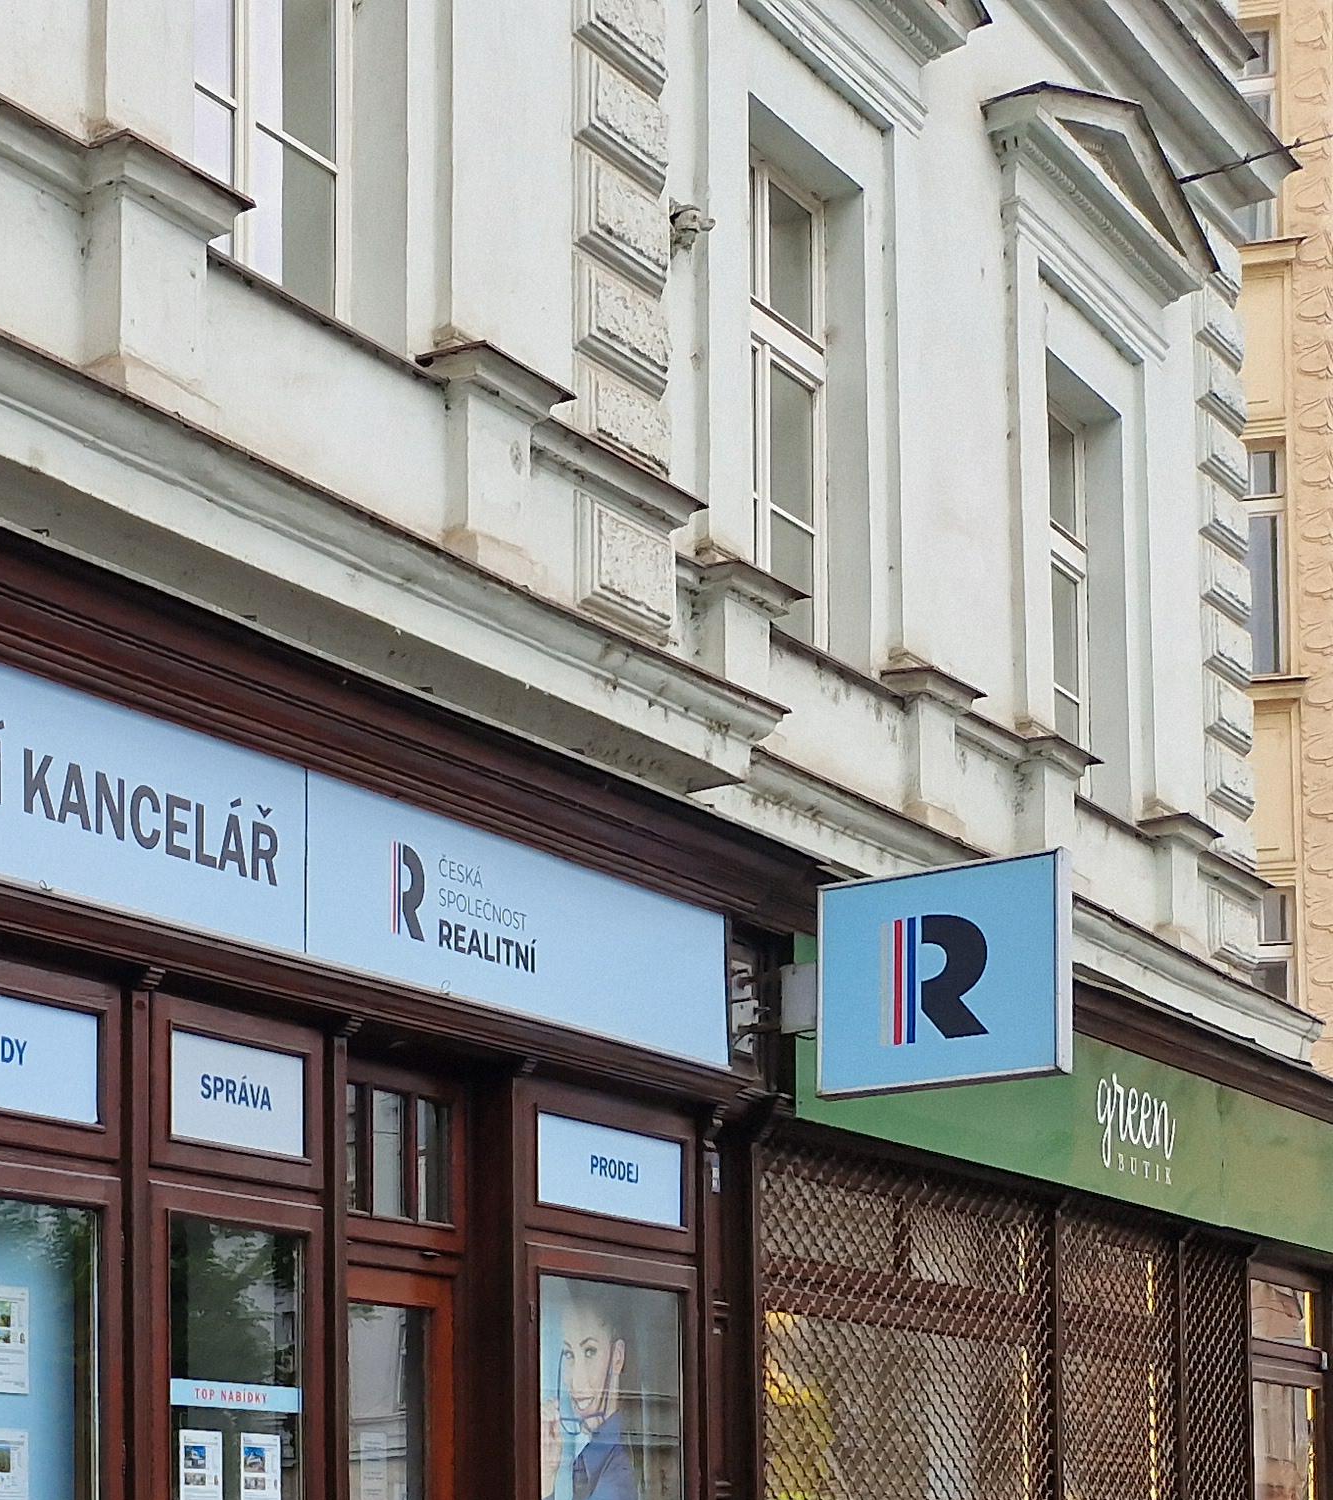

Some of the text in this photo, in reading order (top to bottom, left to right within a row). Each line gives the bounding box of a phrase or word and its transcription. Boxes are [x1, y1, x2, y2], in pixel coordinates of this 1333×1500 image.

[23, 746, 279, 886] KANCELÁŘ
[438, 854, 483, 889] ČESKÁ
[438, 887, 527, 931] SPOLEČNOST
[438, 918, 538, 974] REALITNÍ
[200, 1073, 273, 1112] SPRÁVA
[1097, 1073, 1176, 1168] green
[590, 1154, 639, 1184] PRODEJ
[1118, 1153, 1171, 1185] BUTIK
[195, 1388, 268, 1404] TOP NABÍDKY
